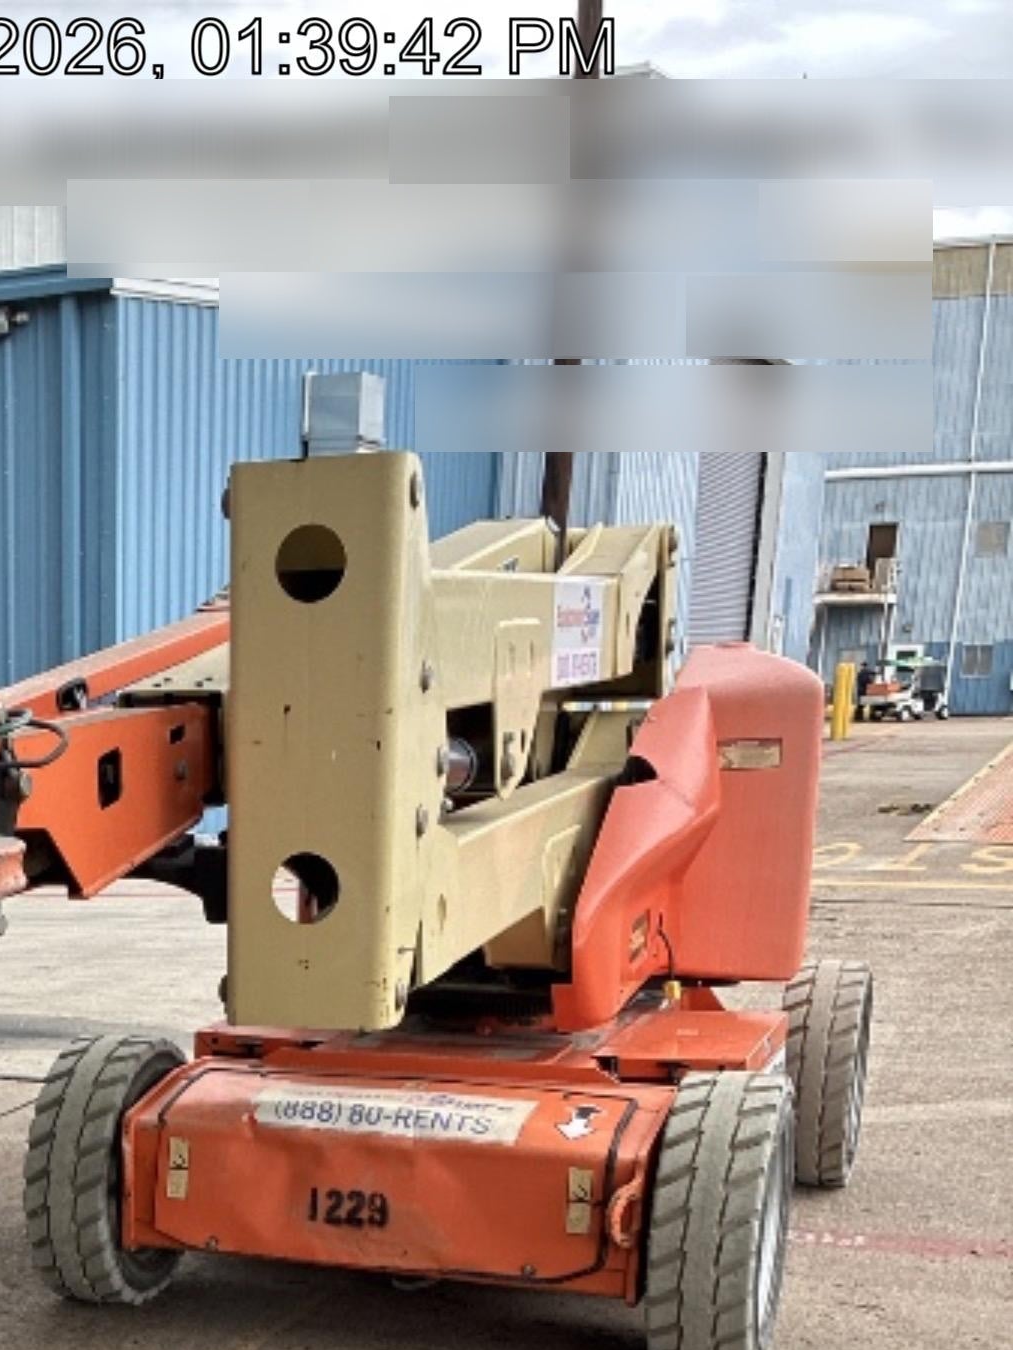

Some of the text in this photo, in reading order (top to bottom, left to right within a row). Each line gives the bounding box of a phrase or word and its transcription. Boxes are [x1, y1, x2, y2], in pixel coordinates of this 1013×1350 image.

[274, 1100, 492, 1134] (888) 80-RENTS
[308, 1187, 390, 1229] 1229
